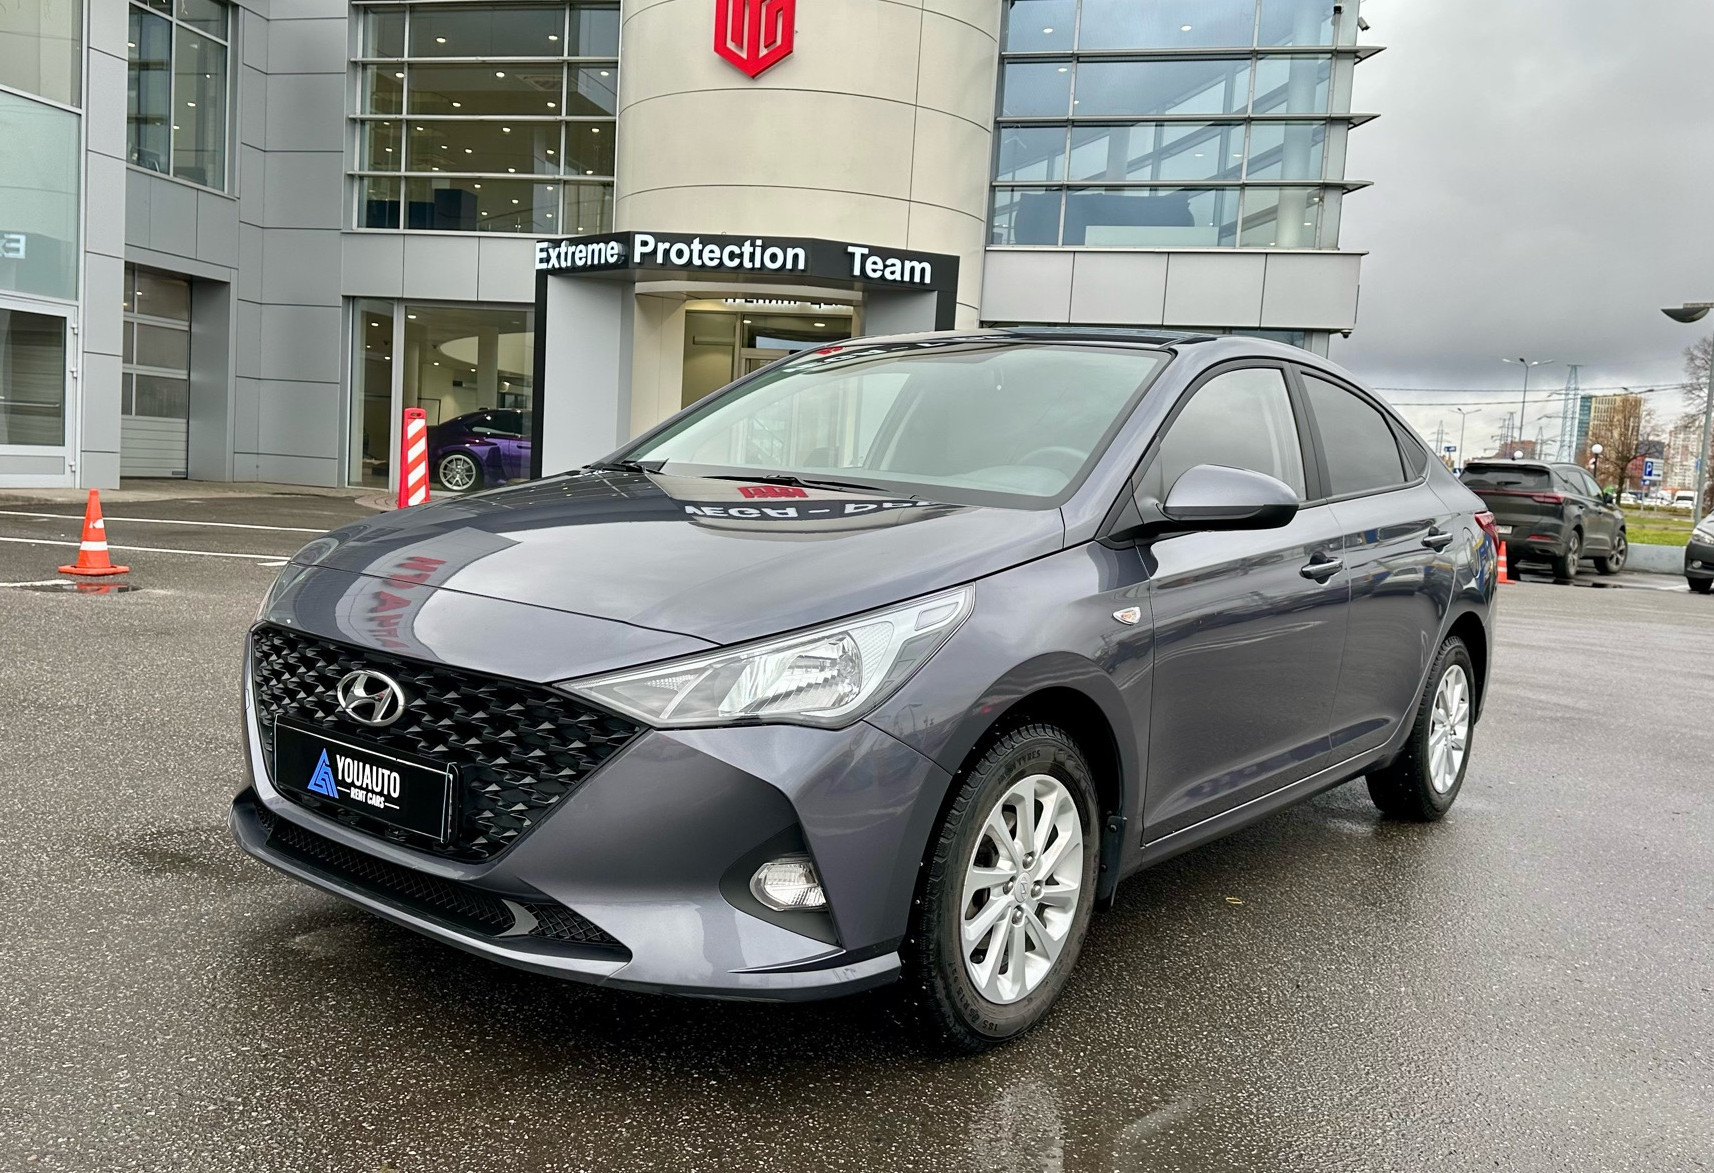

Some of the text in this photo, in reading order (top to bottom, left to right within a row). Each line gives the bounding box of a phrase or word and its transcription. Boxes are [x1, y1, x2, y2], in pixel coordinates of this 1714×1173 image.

[535, 233, 932, 285] Extreme Protection Team
[336, 754, 400, 798] YOUAUTO
[350, 787, 385, 809] RENT CARS
